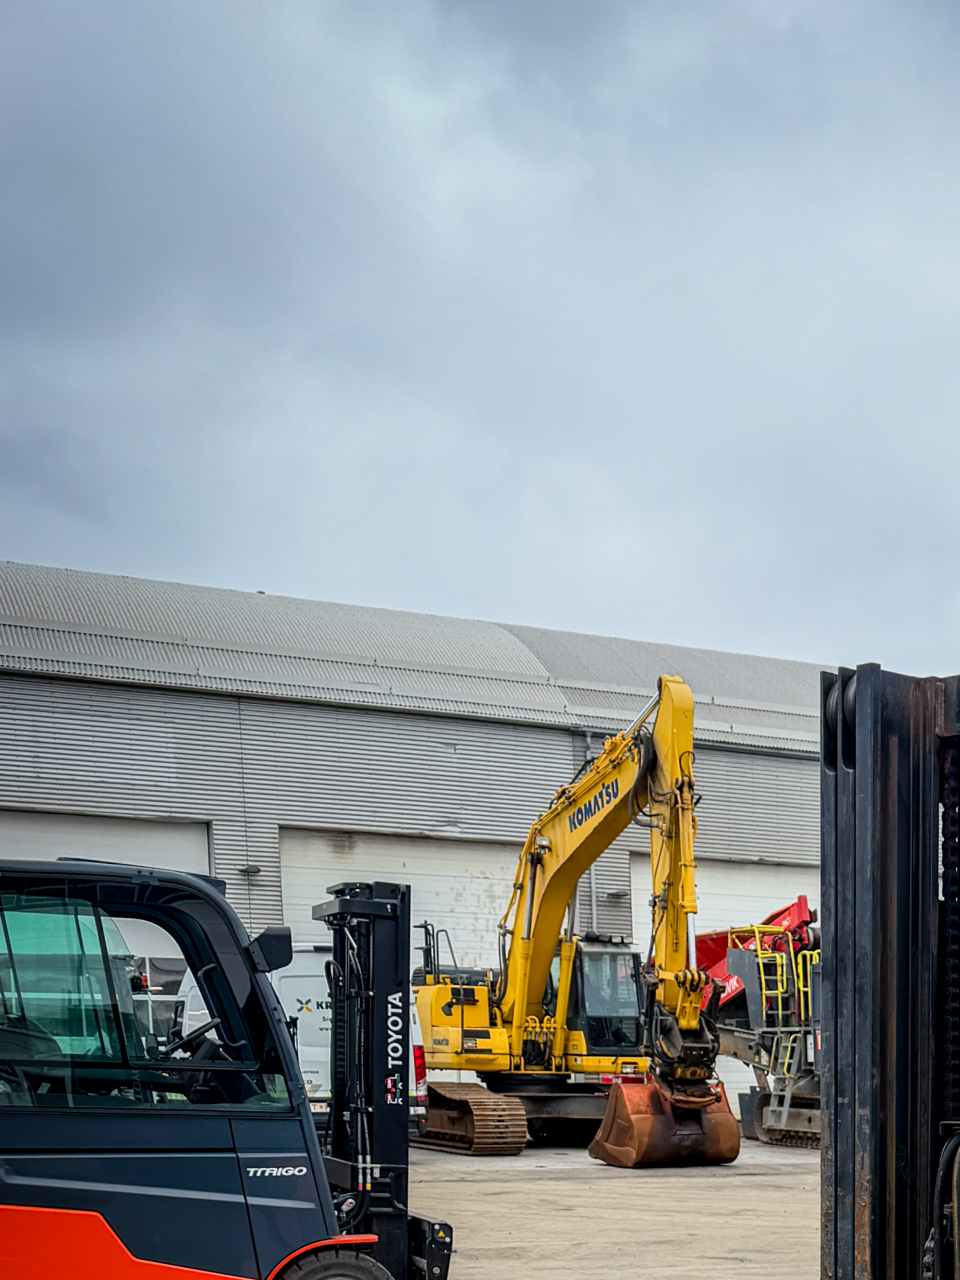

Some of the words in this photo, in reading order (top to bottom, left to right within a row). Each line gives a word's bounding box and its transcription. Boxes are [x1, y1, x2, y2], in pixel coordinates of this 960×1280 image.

[568, 777, 619, 833] KOMATSU
[387, 992, 403, 1069] TOYOTA
[247, 1167, 307, 1177] TRAIGO
